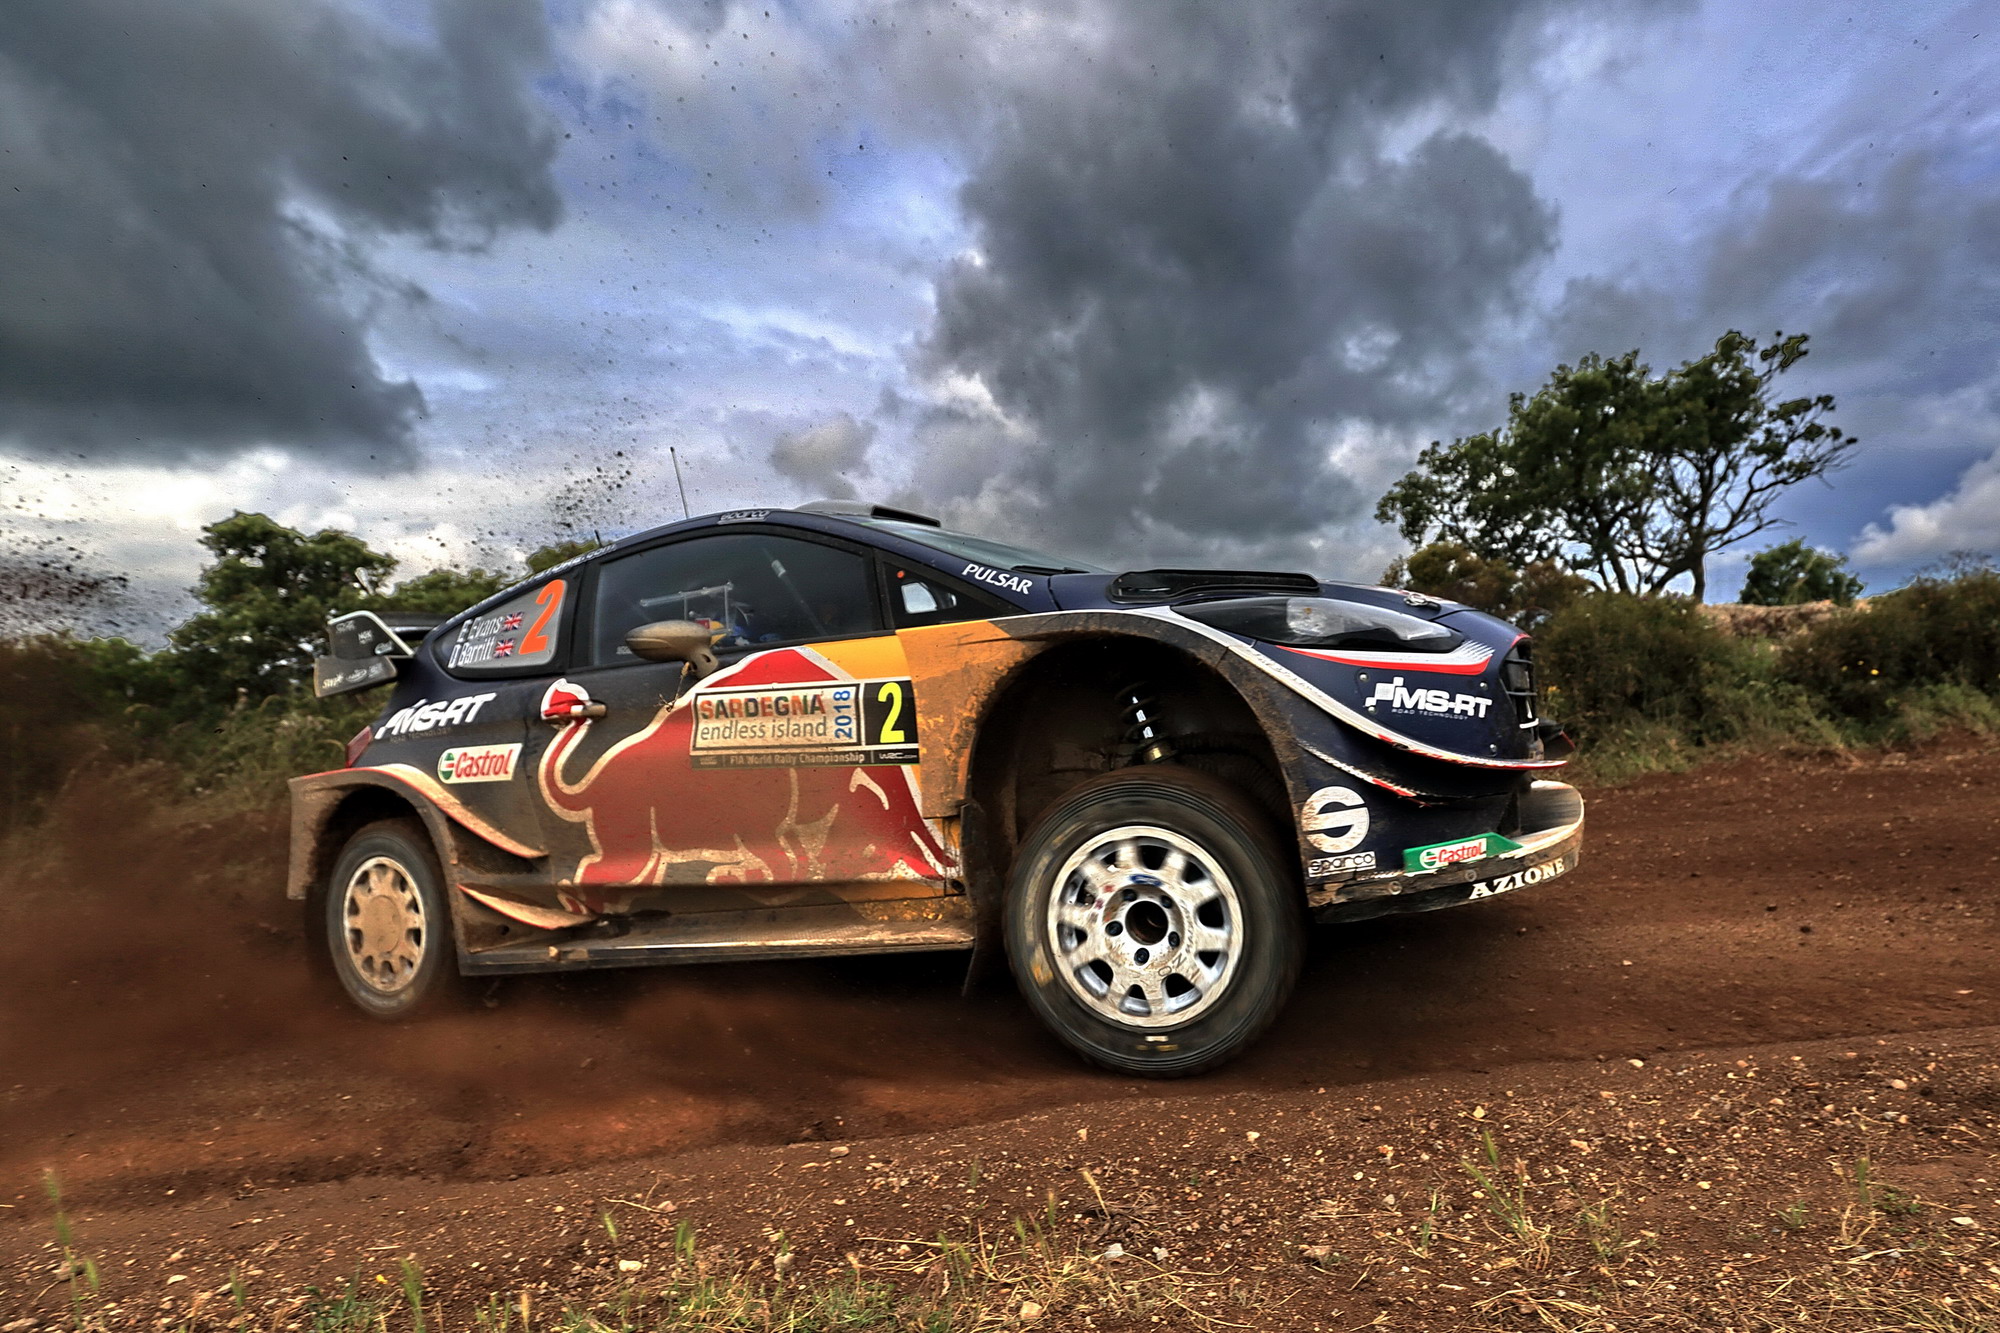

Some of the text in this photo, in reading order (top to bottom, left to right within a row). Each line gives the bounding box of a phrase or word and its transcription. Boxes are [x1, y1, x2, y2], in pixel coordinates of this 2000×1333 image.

[962, 563, 1033, 594] PULSAR
[457, 616, 503, 642] E Evans
[518, 579, 566, 655] 2
[457, 637, 495, 666] Barritt
[700, 694, 826, 720] SARDEGNA
[833, 690, 853, 739] 2018
[878, 682, 905, 743] 2
[1391, 687, 1493, 718] MS-RT
[1419, 711, 1468, 720] TECHNOLOGY
[700, 716, 827, 740] endless island
[455, 749, 513, 779] Castrol
[730, 755, 745, 765] FIA
[746, 755, 773, 765] World
[774, 754, 797, 766] Rally
[800, 752, 865, 764] Championship
[1310, 854, 1373, 874] sparco
[1438, 842, 1483, 862] Castrol
[1469, 858, 1565, 900] AZIONE
